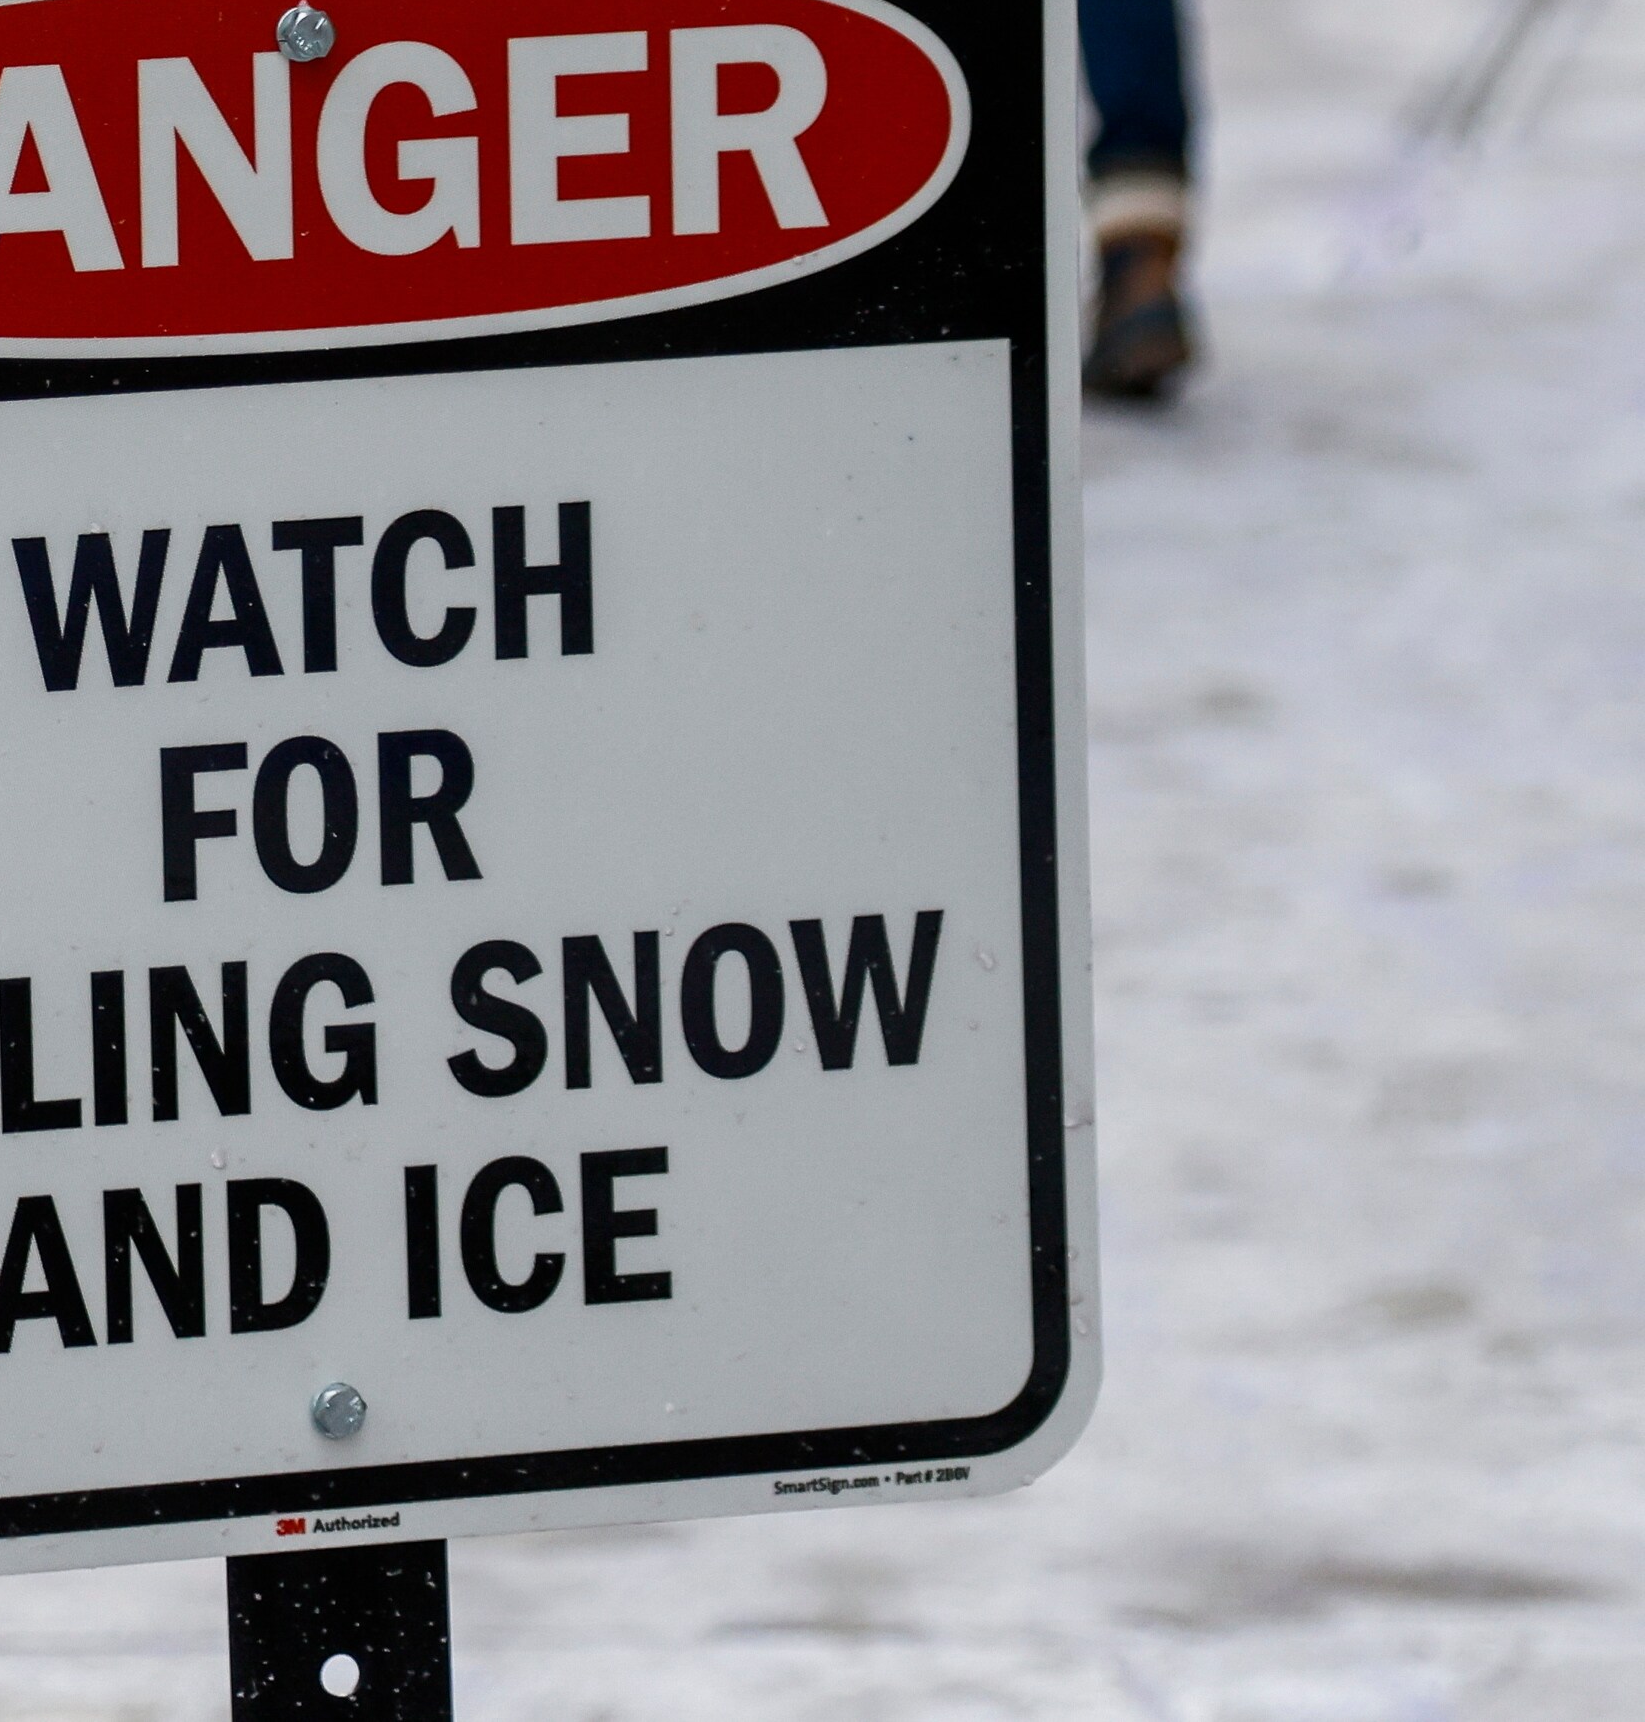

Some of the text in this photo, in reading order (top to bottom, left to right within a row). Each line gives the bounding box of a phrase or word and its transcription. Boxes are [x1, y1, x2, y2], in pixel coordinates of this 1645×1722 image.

[10, 500, 595, 693] WATCH
[159, 728, 484, 903] FOR
[446, 909, 945, 1099] SNOW
[403, 1145, 673, 1321] ICE
[276, 1511, 401, 1537] 3M Authorized
[773, 1476, 880, 1495] SmartSign.com
